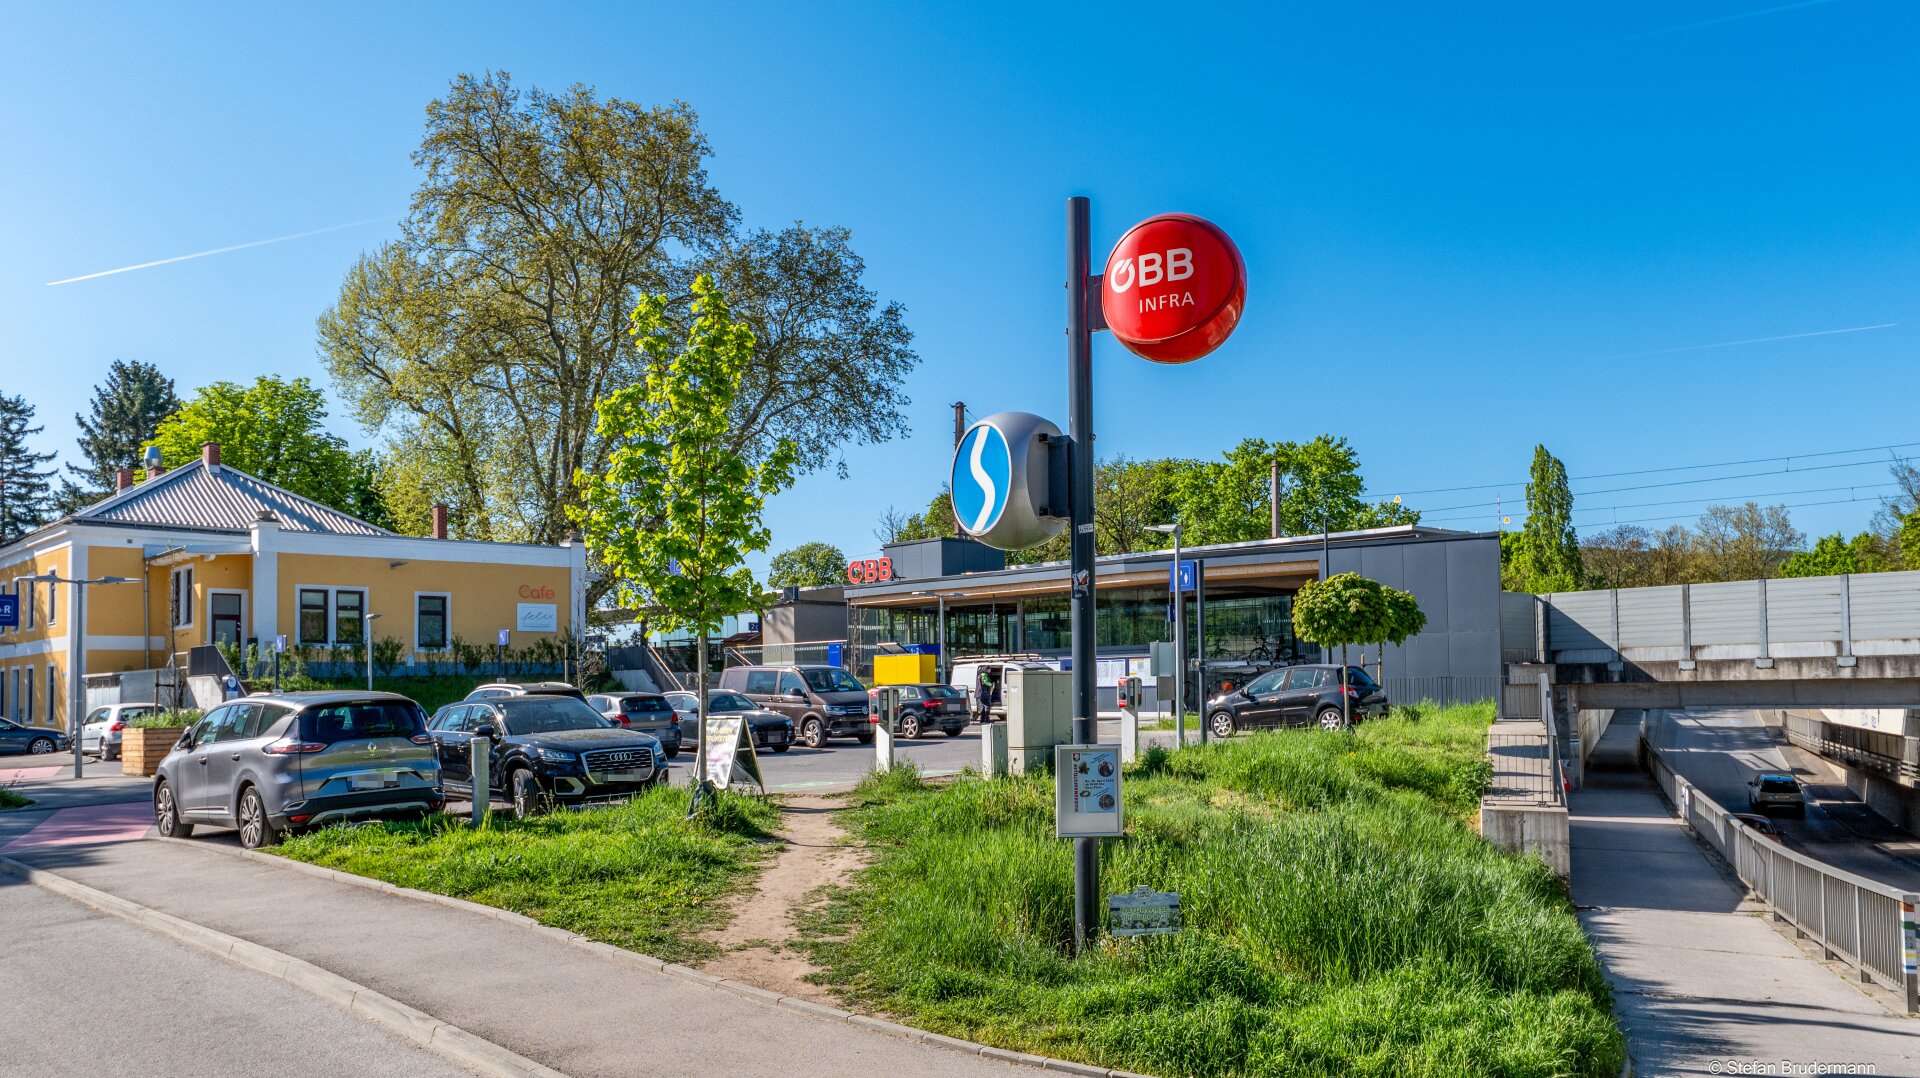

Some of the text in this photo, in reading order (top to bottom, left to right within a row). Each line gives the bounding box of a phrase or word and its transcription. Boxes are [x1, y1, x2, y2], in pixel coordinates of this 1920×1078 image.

[1110, 247, 1194, 294] ÖBB
[1138, 291, 1195, 314] INFRA
[847, 556, 892, 585] ÖBB
